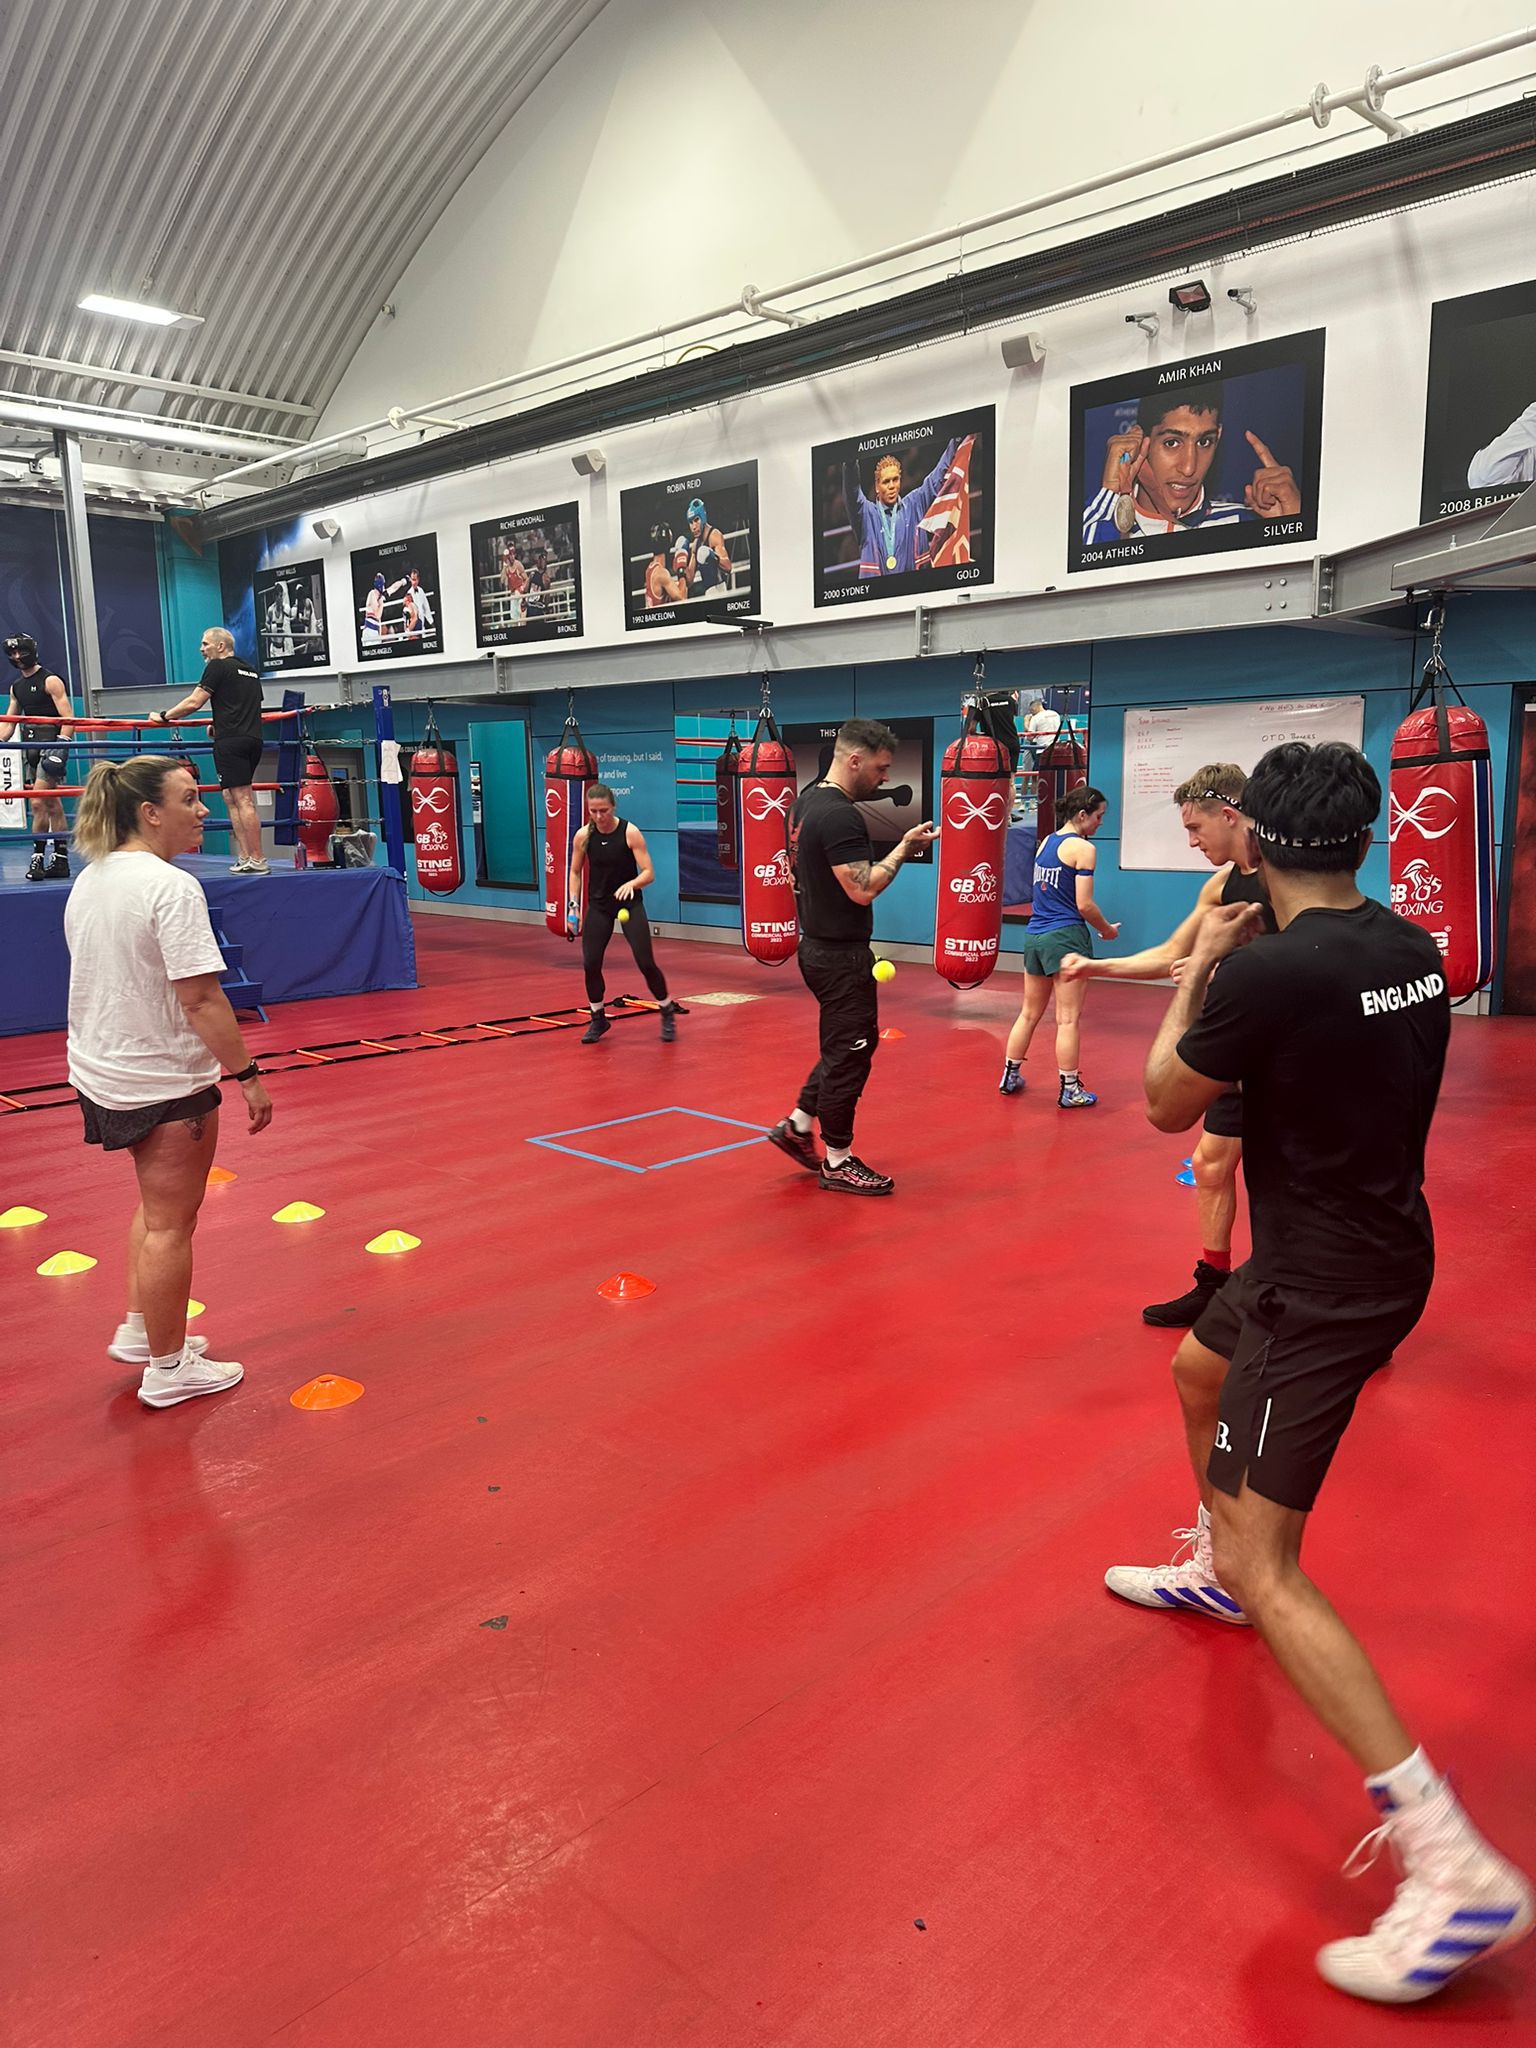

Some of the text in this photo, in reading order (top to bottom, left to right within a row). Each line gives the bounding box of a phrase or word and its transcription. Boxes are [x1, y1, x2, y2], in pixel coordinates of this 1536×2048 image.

[1158, 360, 1222, 385] AMIR KHAN
[858, 426, 933, 452] AUDLEY HARRISON
[667, 478, 701, 494] ROBIN REID
[1439, 499, 1471, 514] 2008
[500, 514, 545, 530] RICHIE WOODHALL
[1263, 522, 1303, 537] SILVER
[1081, 544, 1145, 563] 2004 ATHENS
[956, 568, 980, 580] GOLD
[823, 584, 871, 600] 2000 SYDNEY
[727, 600, 750, 611] BRONZE
[632, 611, 676, 624] 1992 BARCELONA
[557, 624, 577, 633] BRONZE
[493, 633, 508, 641] SEOUL
[820, 729, 836, 738] THIS
[607, 753, 633, 764] training,
[633, 752, 645, 762] but
[648, 752, 664, 762] said,
[603, 770, 627, 779] and live
[416, 833, 430, 844] GB
[421, 843, 449, 852] BOXING
[417, 859, 452, 869] STING
[754, 865, 776, 878] GB
[762, 877, 790, 887] BOXIN
[950, 878, 975, 893] GB
[958, 892, 997, 903] BOXING
[1390, 883, 1408, 903] GB
[1394, 900, 1444, 917] BOXING
[751, 921, 796, 934] STING
[945, 938, 997, 952] STING
[944, 949, 979, 957] COMMERCIAL
[1360, 973, 1444, 1016] ENGLAND
[1215, 1420, 1232, 1453] B.
